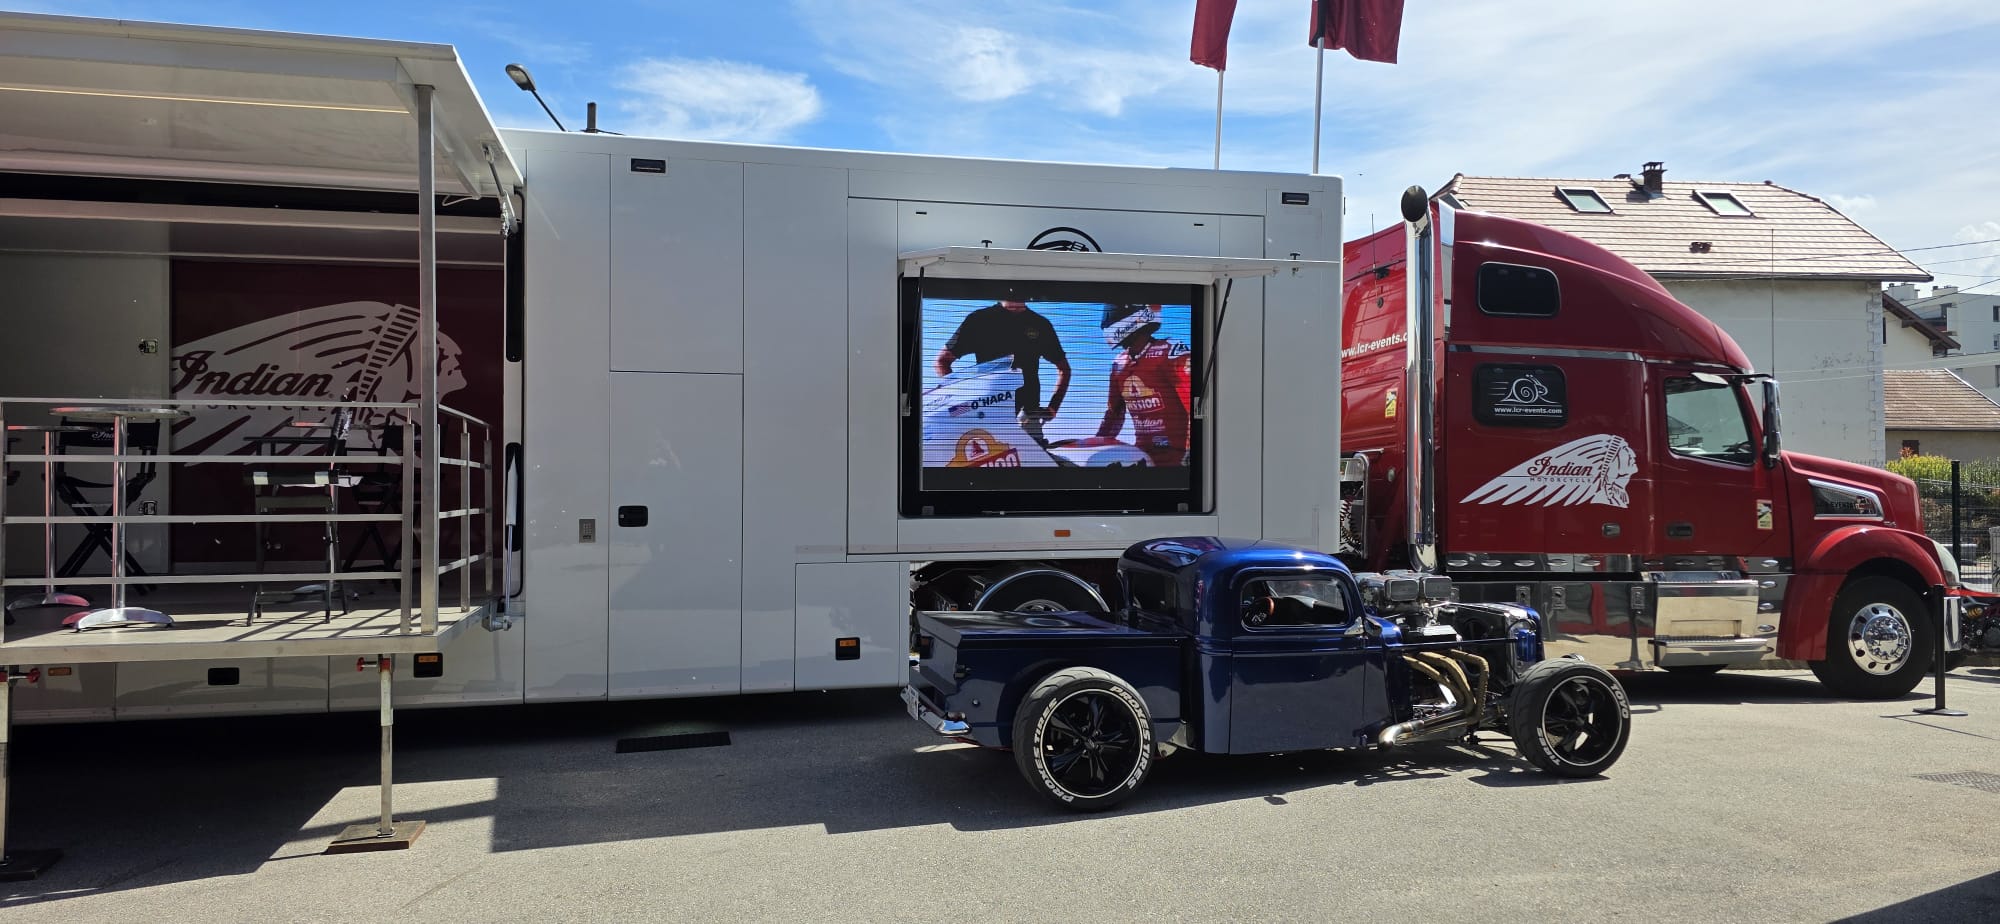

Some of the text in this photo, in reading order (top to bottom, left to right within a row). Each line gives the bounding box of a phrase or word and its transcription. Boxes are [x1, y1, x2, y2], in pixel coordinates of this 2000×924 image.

[172, 350, 333, 397] Indian
[971, 391, 1012, 410] O'HARA
[1494, 406, 1562, 414] www.lcr-events.com
[1527, 456, 1593, 476] Indian
[1611, 683, 1629, 719] TOYO
[1033, 697, 1075, 803] PROXES TIRES
[1110, 685, 1151, 790] PROXES TIRES
[1536, 727, 1561, 766] TIRES
